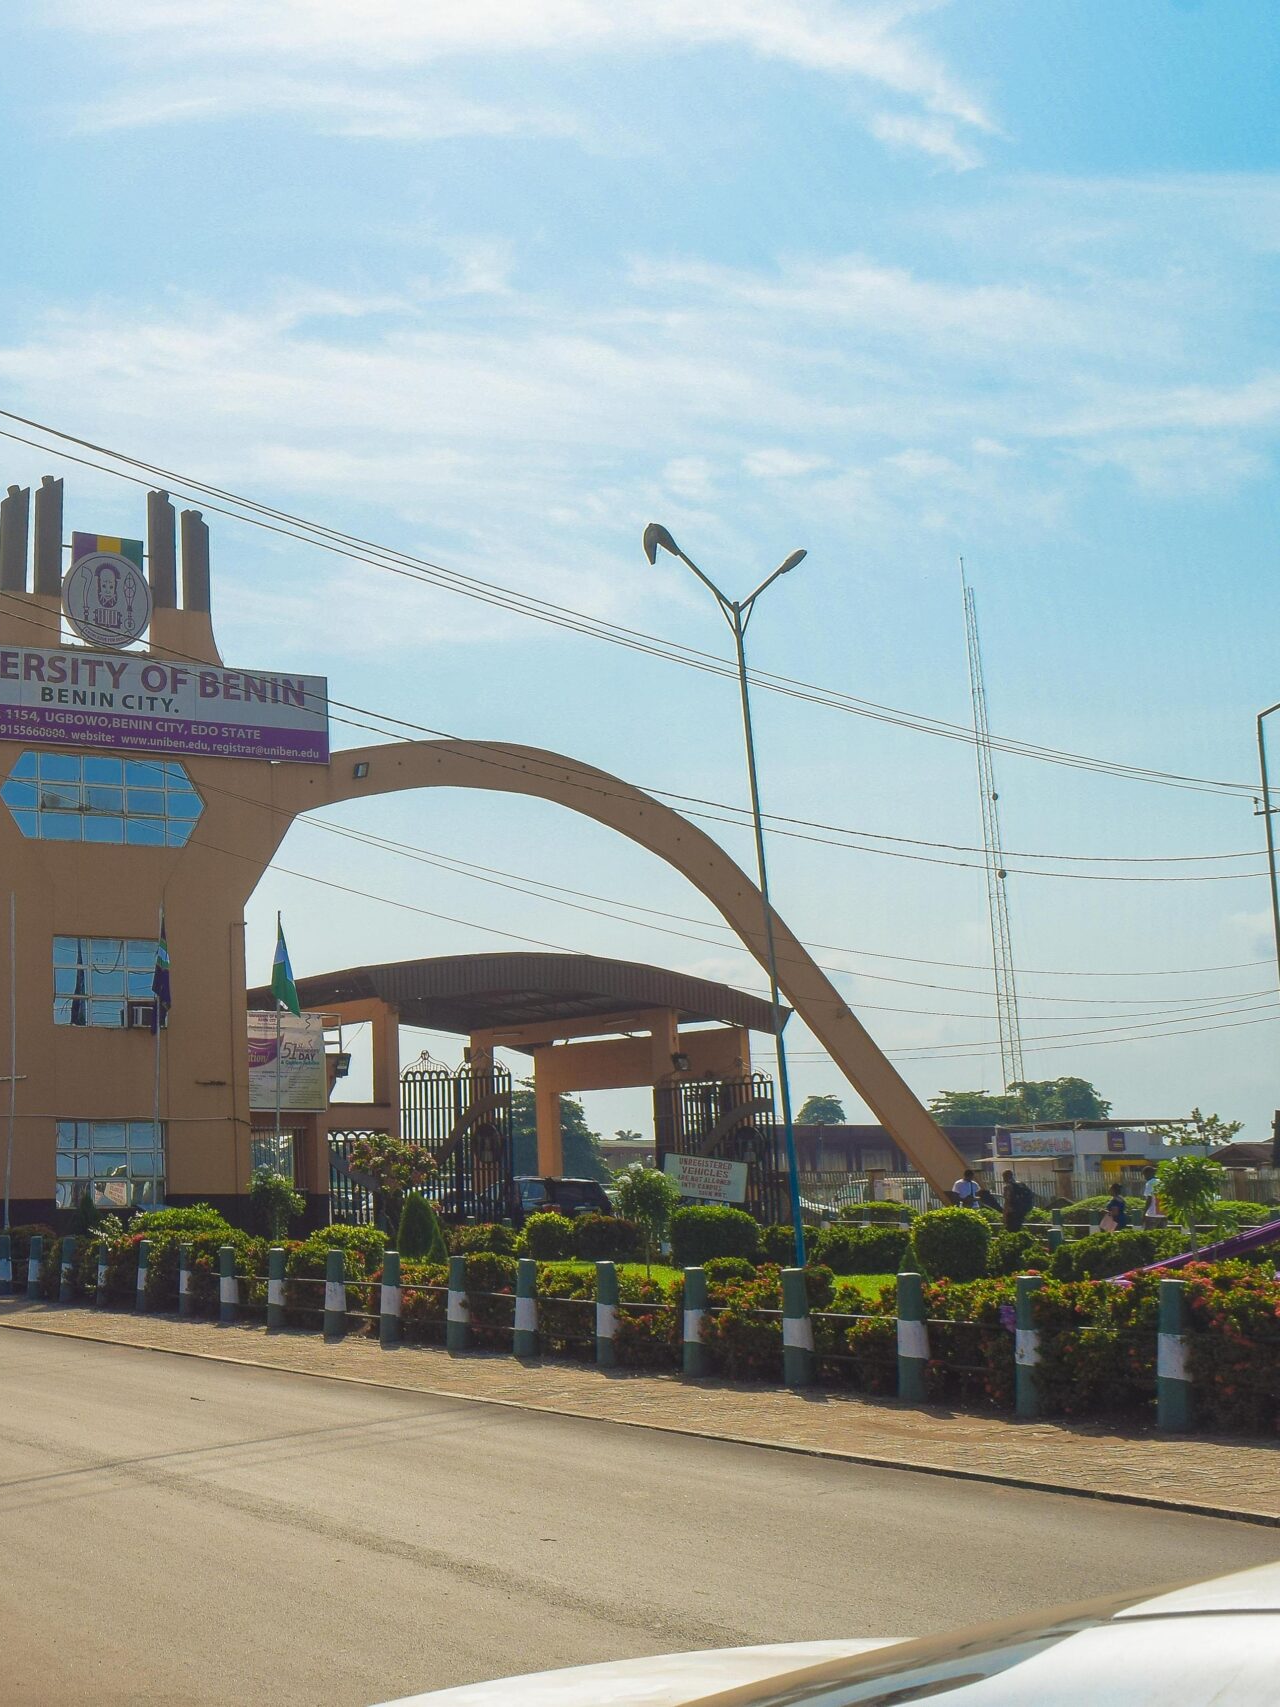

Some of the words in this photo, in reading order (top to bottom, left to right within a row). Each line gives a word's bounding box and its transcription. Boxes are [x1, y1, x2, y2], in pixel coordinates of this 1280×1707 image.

[141, 664, 189, 696] OF
[198, 671, 306, 707] BENIN
[40, 687, 114, 708] BENIN
[121, 694, 180, 715] CITY.
[6, 709, 41, 723] 1154,
[155, 721, 188, 736] CITY,
[191, 724, 219, 737] EDO
[221, 727, 261, 740] STATE
[71, 731, 115, 743] website:
[120, 734, 211, 752] www.uniben.edu,
[212, 743, 320, 759] registrar@uniben.edu
[679, 1157, 733, 1170] UNREGISTERED
[682, 1166, 729, 1179] VEHICLES
[703, 1177, 731, 1186] ALLOWED
